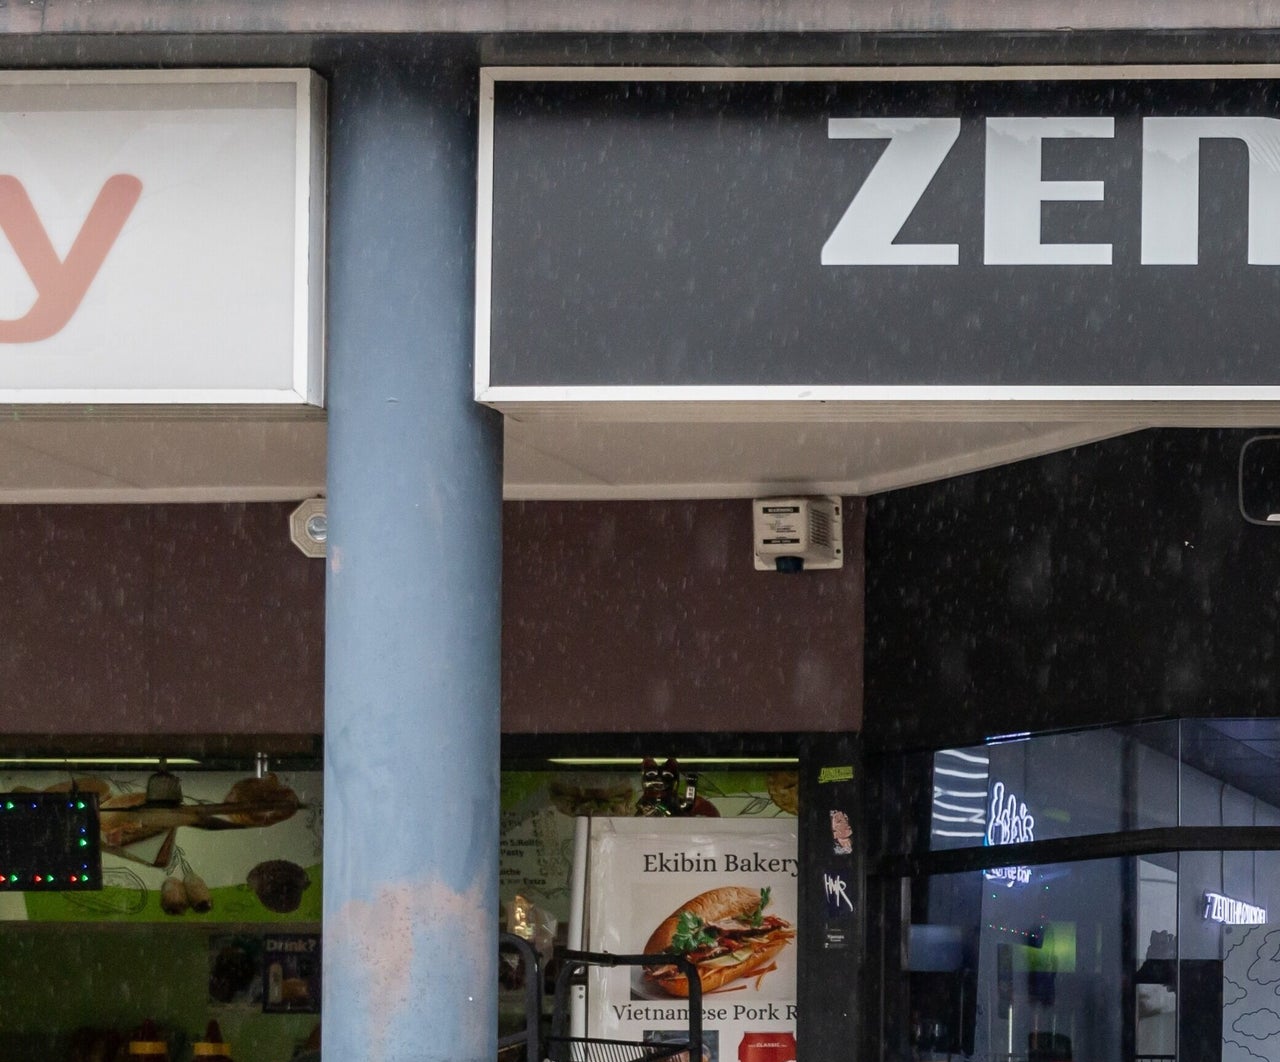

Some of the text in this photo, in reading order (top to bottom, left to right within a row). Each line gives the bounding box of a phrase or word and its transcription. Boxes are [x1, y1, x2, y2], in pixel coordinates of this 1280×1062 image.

[643, 852, 800, 878] Ekibin Bakery
[266, 939, 316, 952] Drink?
[733, 1003, 781, 1021] Pork
